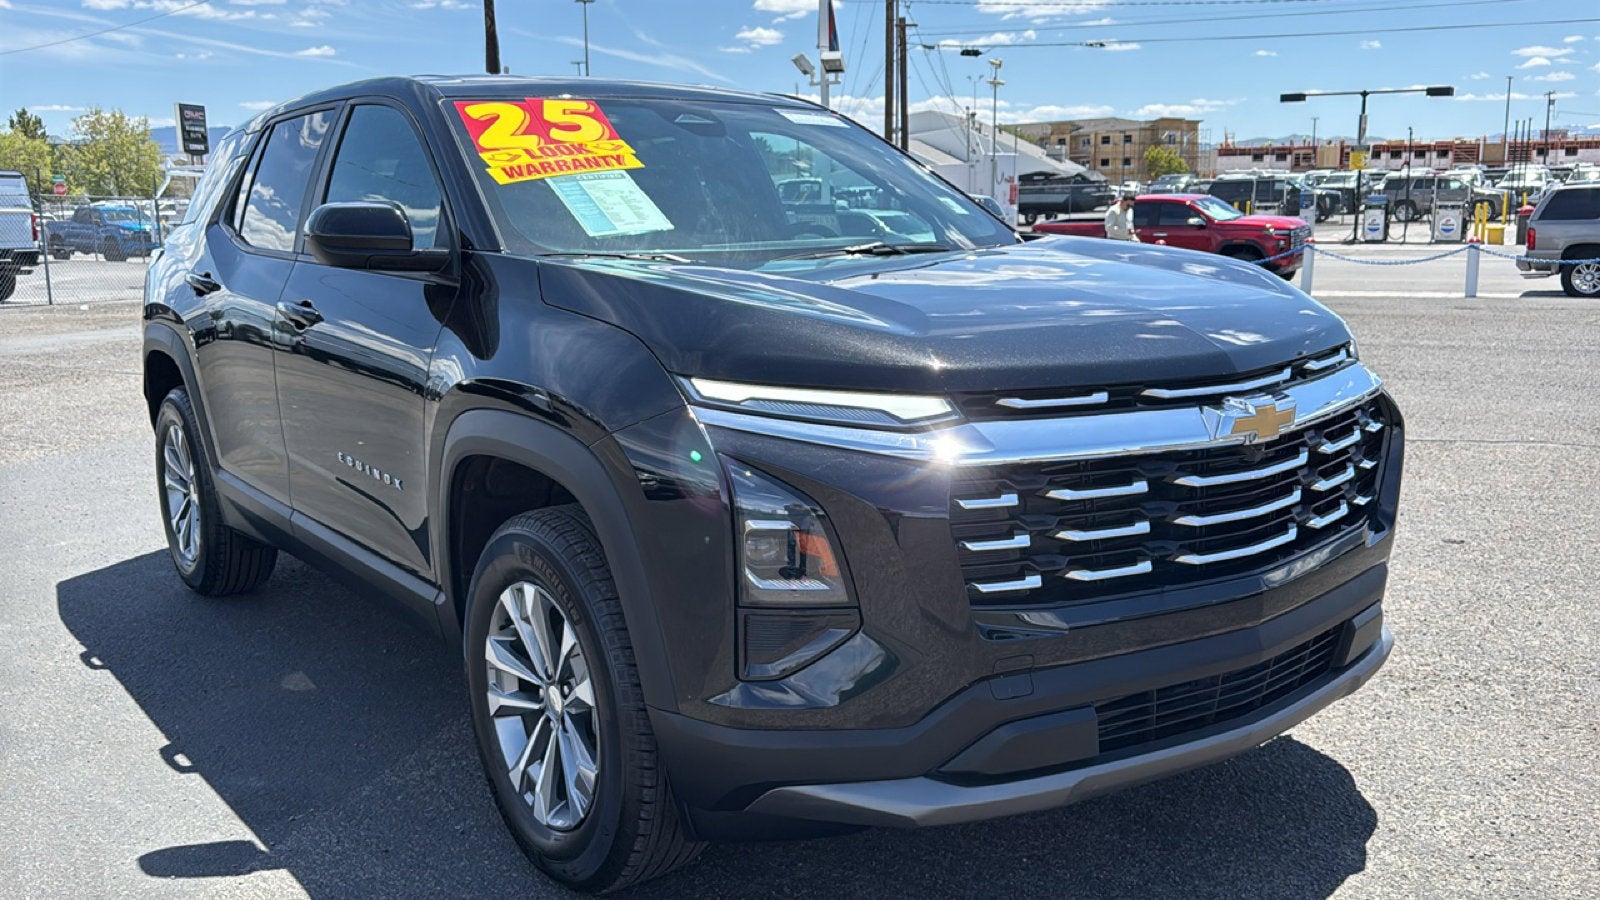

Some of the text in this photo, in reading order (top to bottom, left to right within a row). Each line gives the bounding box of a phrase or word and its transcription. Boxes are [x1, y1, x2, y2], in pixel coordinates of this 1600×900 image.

[464, 100, 610, 150] 25
[502, 154, 626, 179] WARRANTY
[526, 142, 594, 160] LOOK
[338, 451, 403, 491] EQUINOX
[532, 555, 581, 622] MICHELIN
